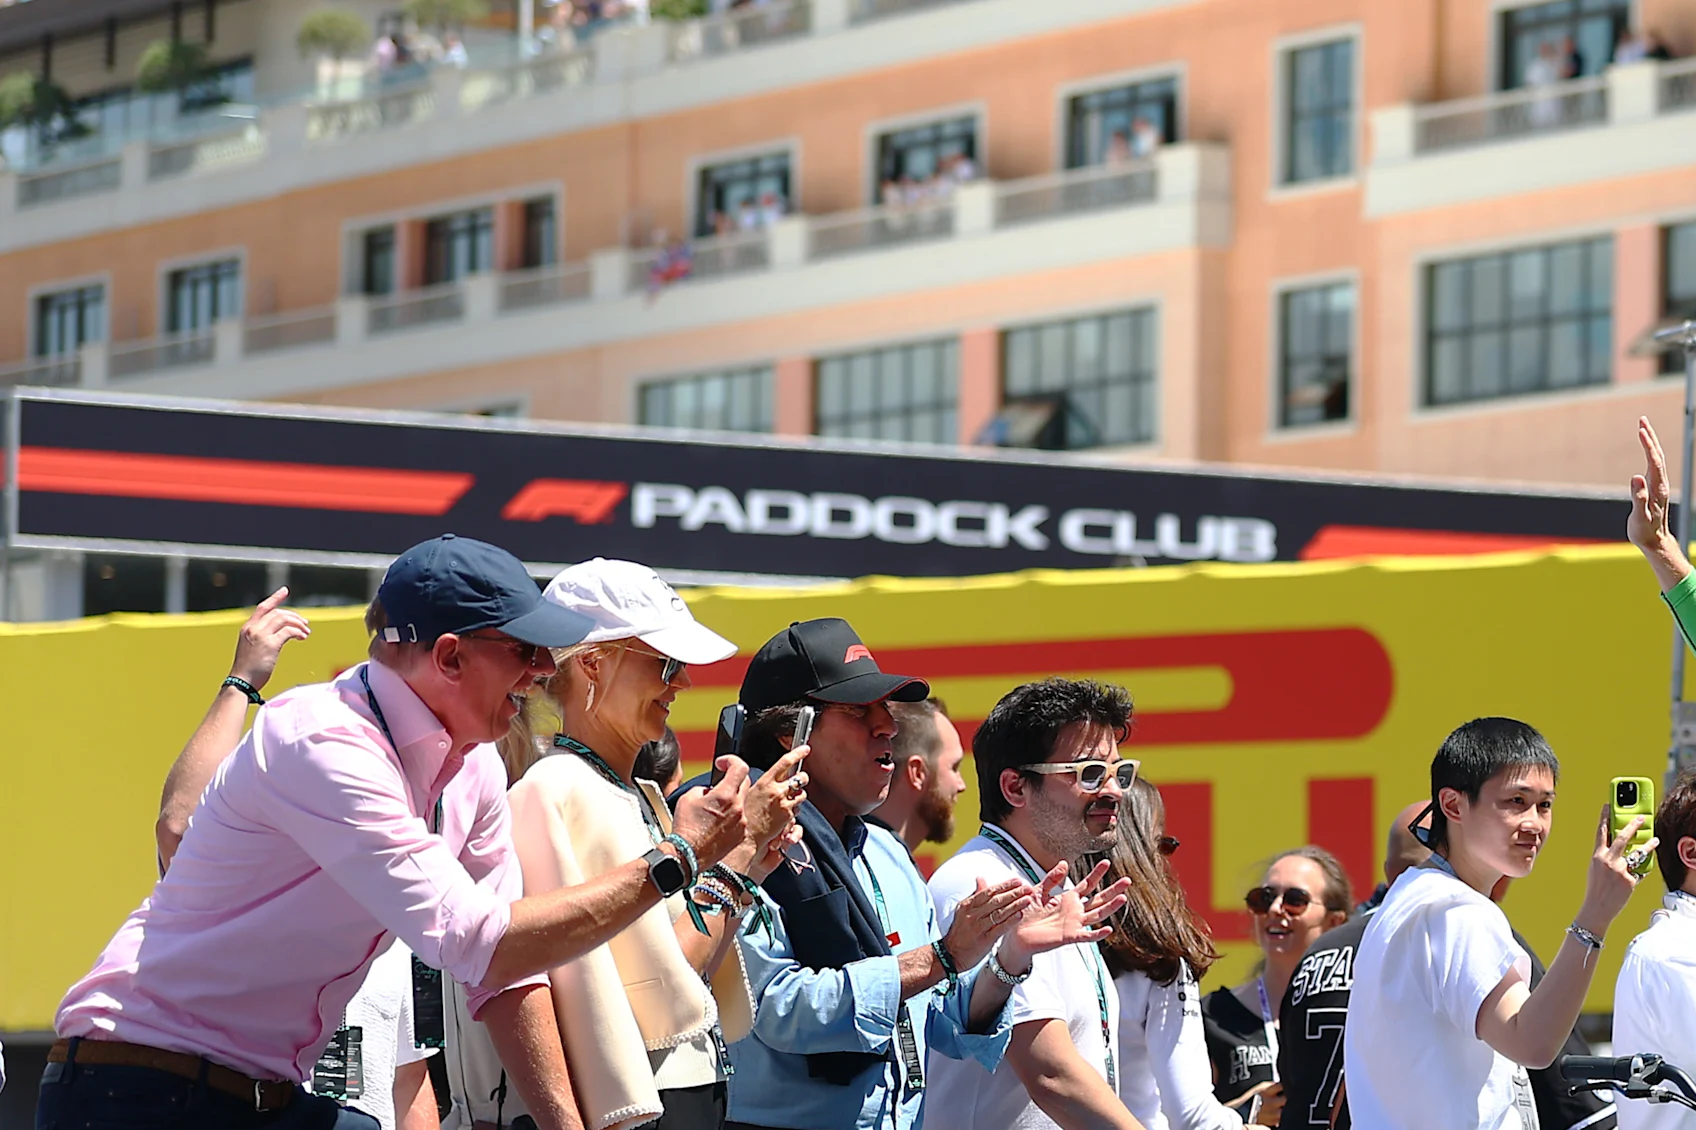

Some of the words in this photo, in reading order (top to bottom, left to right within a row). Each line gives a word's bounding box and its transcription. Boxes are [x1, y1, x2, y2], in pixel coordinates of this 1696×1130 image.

[631, 481, 1050, 551] PADDOCK
[1059, 506, 1278, 562] CLUB
[1291, 946, 1355, 1006] STA
